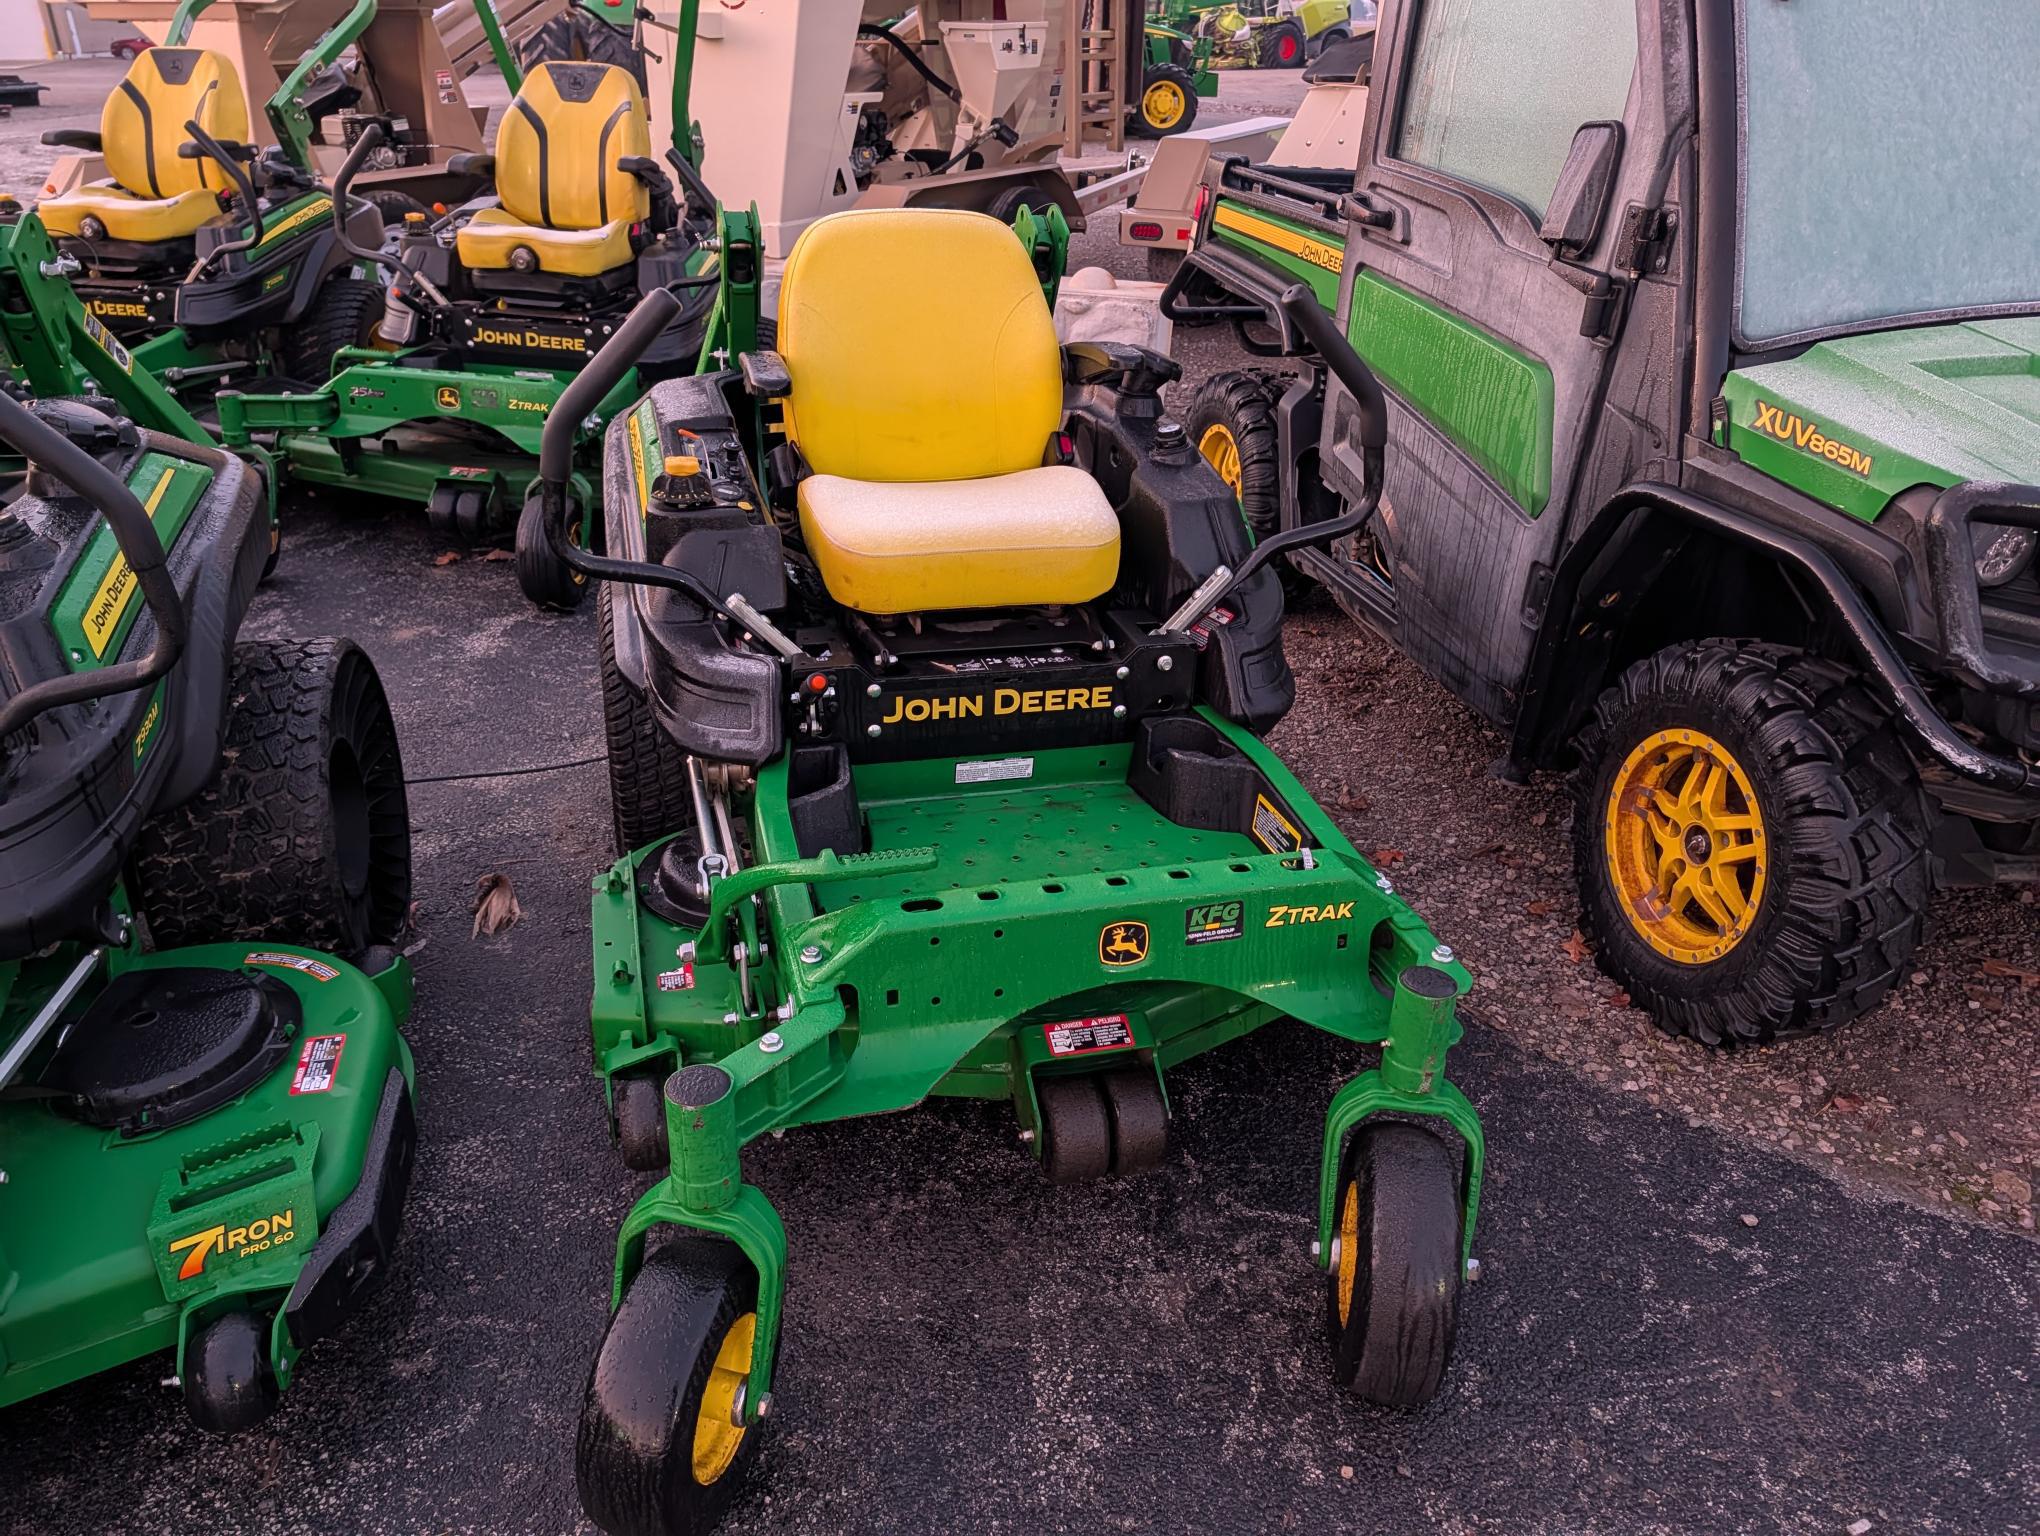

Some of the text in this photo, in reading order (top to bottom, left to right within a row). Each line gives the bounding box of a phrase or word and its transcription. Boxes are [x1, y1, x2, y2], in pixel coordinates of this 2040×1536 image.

[1297, 241, 1322, 263] JOHN
[94, 300, 148, 317] DEERE
[473, 327, 586, 351] JOHN DEERE
[508, 399, 549, 412] ZTRAK
[1754, 401, 1872, 476] XUV865M
[91, 600, 114, 634] JOHN
[883, 686, 1113, 724] JOHN DEERE
[1190, 902, 1241, 927] KFG
[1265, 901, 1356, 928] ZTRAK
[240, 1231, 295, 1258] PRO 60
